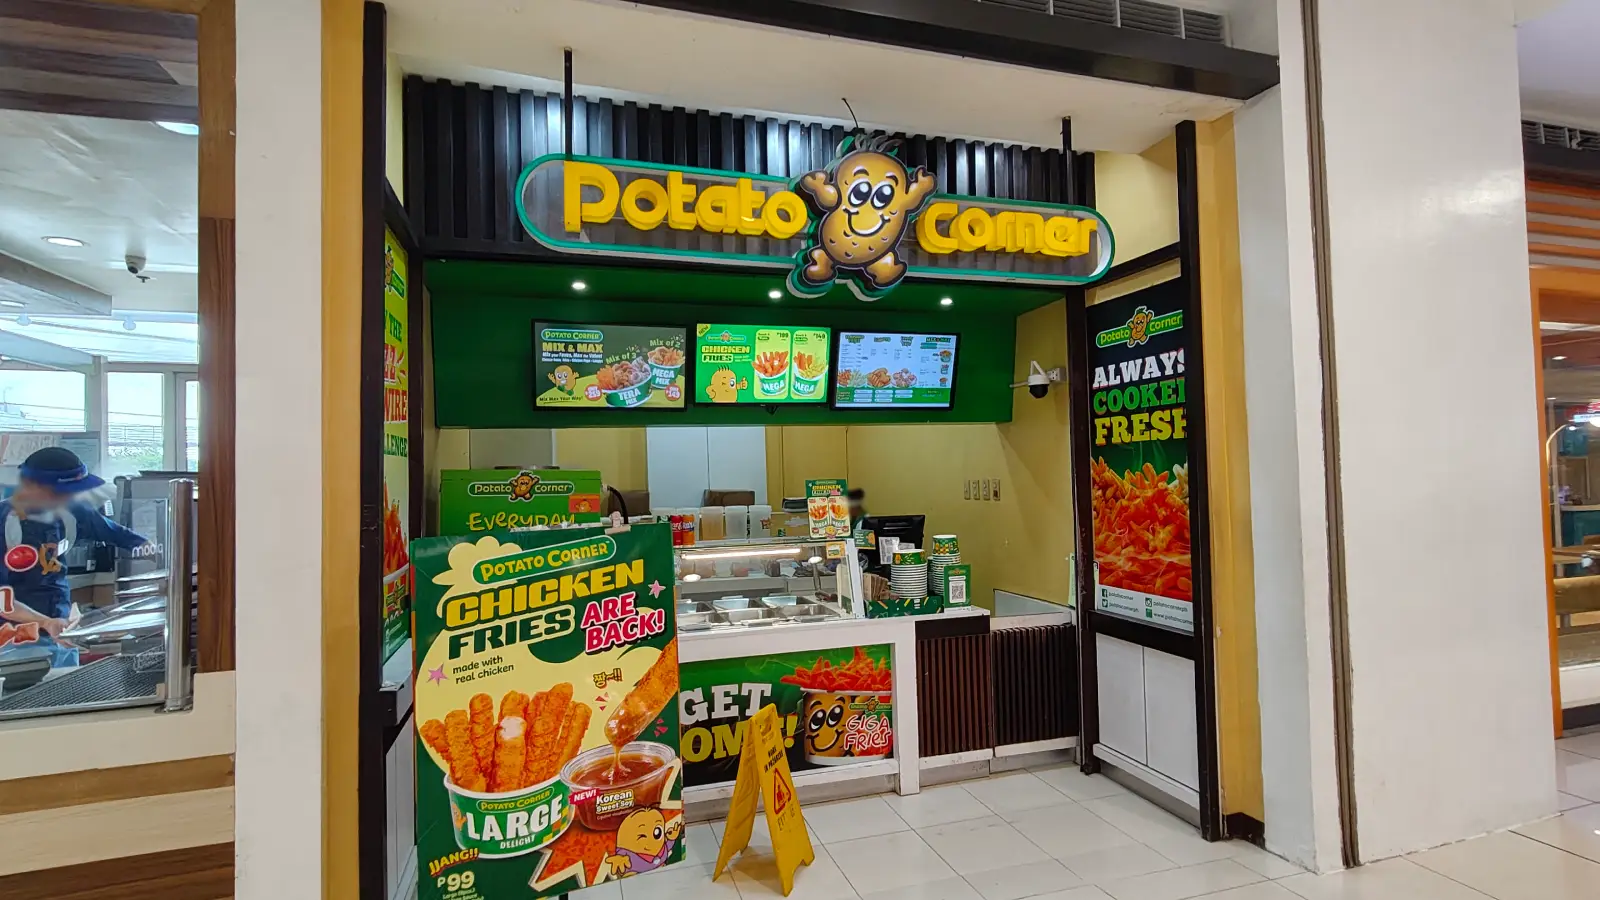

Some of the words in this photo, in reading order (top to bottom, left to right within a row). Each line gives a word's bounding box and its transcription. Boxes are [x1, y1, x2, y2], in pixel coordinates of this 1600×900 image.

[388, 312, 403, 343] THE
[545, 331, 572, 339] POTATO
[573, 332, 600, 340] CORNER
[1100, 329, 1130, 344] Potato
[1150, 315, 1182, 331] Corner
[543, 342, 565, 352] MIX
[568, 344, 576, 352] &
[577, 343, 603, 353] MAX
[650, 338, 662, 347] Mix
[675, 340, 681, 348] 2
[702, 345, 750, 353] CHICKEN
[606, 354, 621, 364] Mix
[703, 354, 732, 362] FRIES
[653, 368, 675, 378] MEGA
[656, 377, 670, 385] MIX
[762, 380, 785, 391] MEGA
[795, 381, 815, 392] MEGA
[618, 388, 641, 400] TERA
[474, 484, 513, 493] Potato
[534, 484, 568, 493] Corner
[480, 554, 544, 581] POTATO
[547, 541, 608, 568] CORNER
[445, 558, 645, 628] CHICKEN
[581, 592, 636, 629] ARE
[447, 608, 573, 660] FRIES
[585, 608, 665, 654] BACK!
[452, 662, 480, 674] made
[481, 655, 504, 667] with
[455, 673, 476, 684] real
[477, 663, 515, 679] chicken
[680, 683, 773, 726] GET
[845, 714, 890, 732] GIGA
[481, 801, 515, 811] POTATO
[516, 790, 551, 807] CORNER
[573, 788, 597, 803] NEW!
[596, 790, 632, 805] Korean
[596, 802, 619, 812] Sweet
[466, 793, 563, 842] LARGE
[500, 833, 536, 850] DELIGHT
[428, 847, 479, 877] JJANG!!
